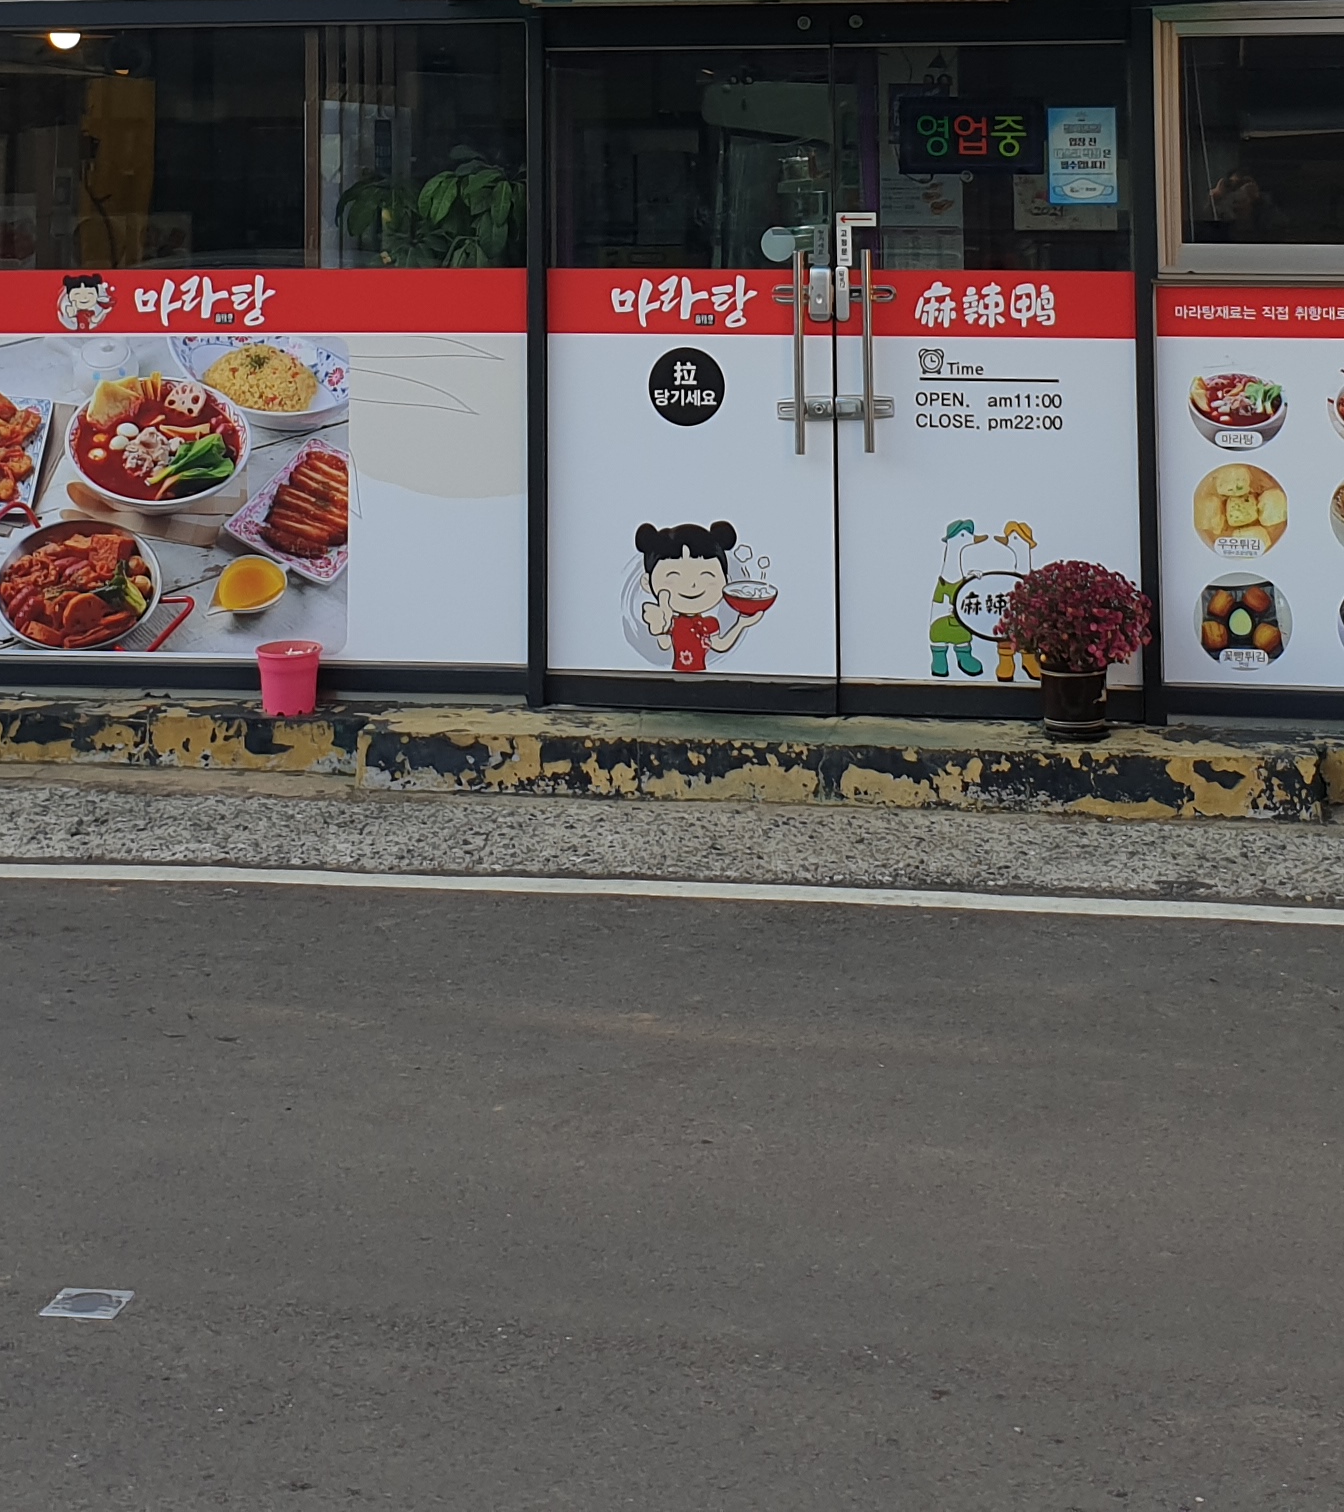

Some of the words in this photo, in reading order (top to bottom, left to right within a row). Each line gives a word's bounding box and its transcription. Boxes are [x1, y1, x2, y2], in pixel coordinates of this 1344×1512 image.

[916, 114, 1027, 157] 영업중
[134, 274, 276, 327] 마라탕
[611, 274, 758, 328] 마라탕
[914, 281, 1056, 329] 麻辣鸭
[1174, 305, 1256, 321] 마라탕재료는
[1261, 305, 1290, 320] 직접
[673, 361, 698, 386] 拉
[947, 361, 985, 376] Time
[653, 388, 718, 407] 당기세요
[915, 392, 971, 408] OPEN.
[987, 393, 1063, 409] am11:00
[915, 413, 981, 430] CLOSE.
[987, 415, 1064, 431] pm22:00
[1221, 433, 1254, 446] 마라탕
[1217, 538, 1261, 551] 우유튀김
[960, 591, 1008, 616] 麻辣
